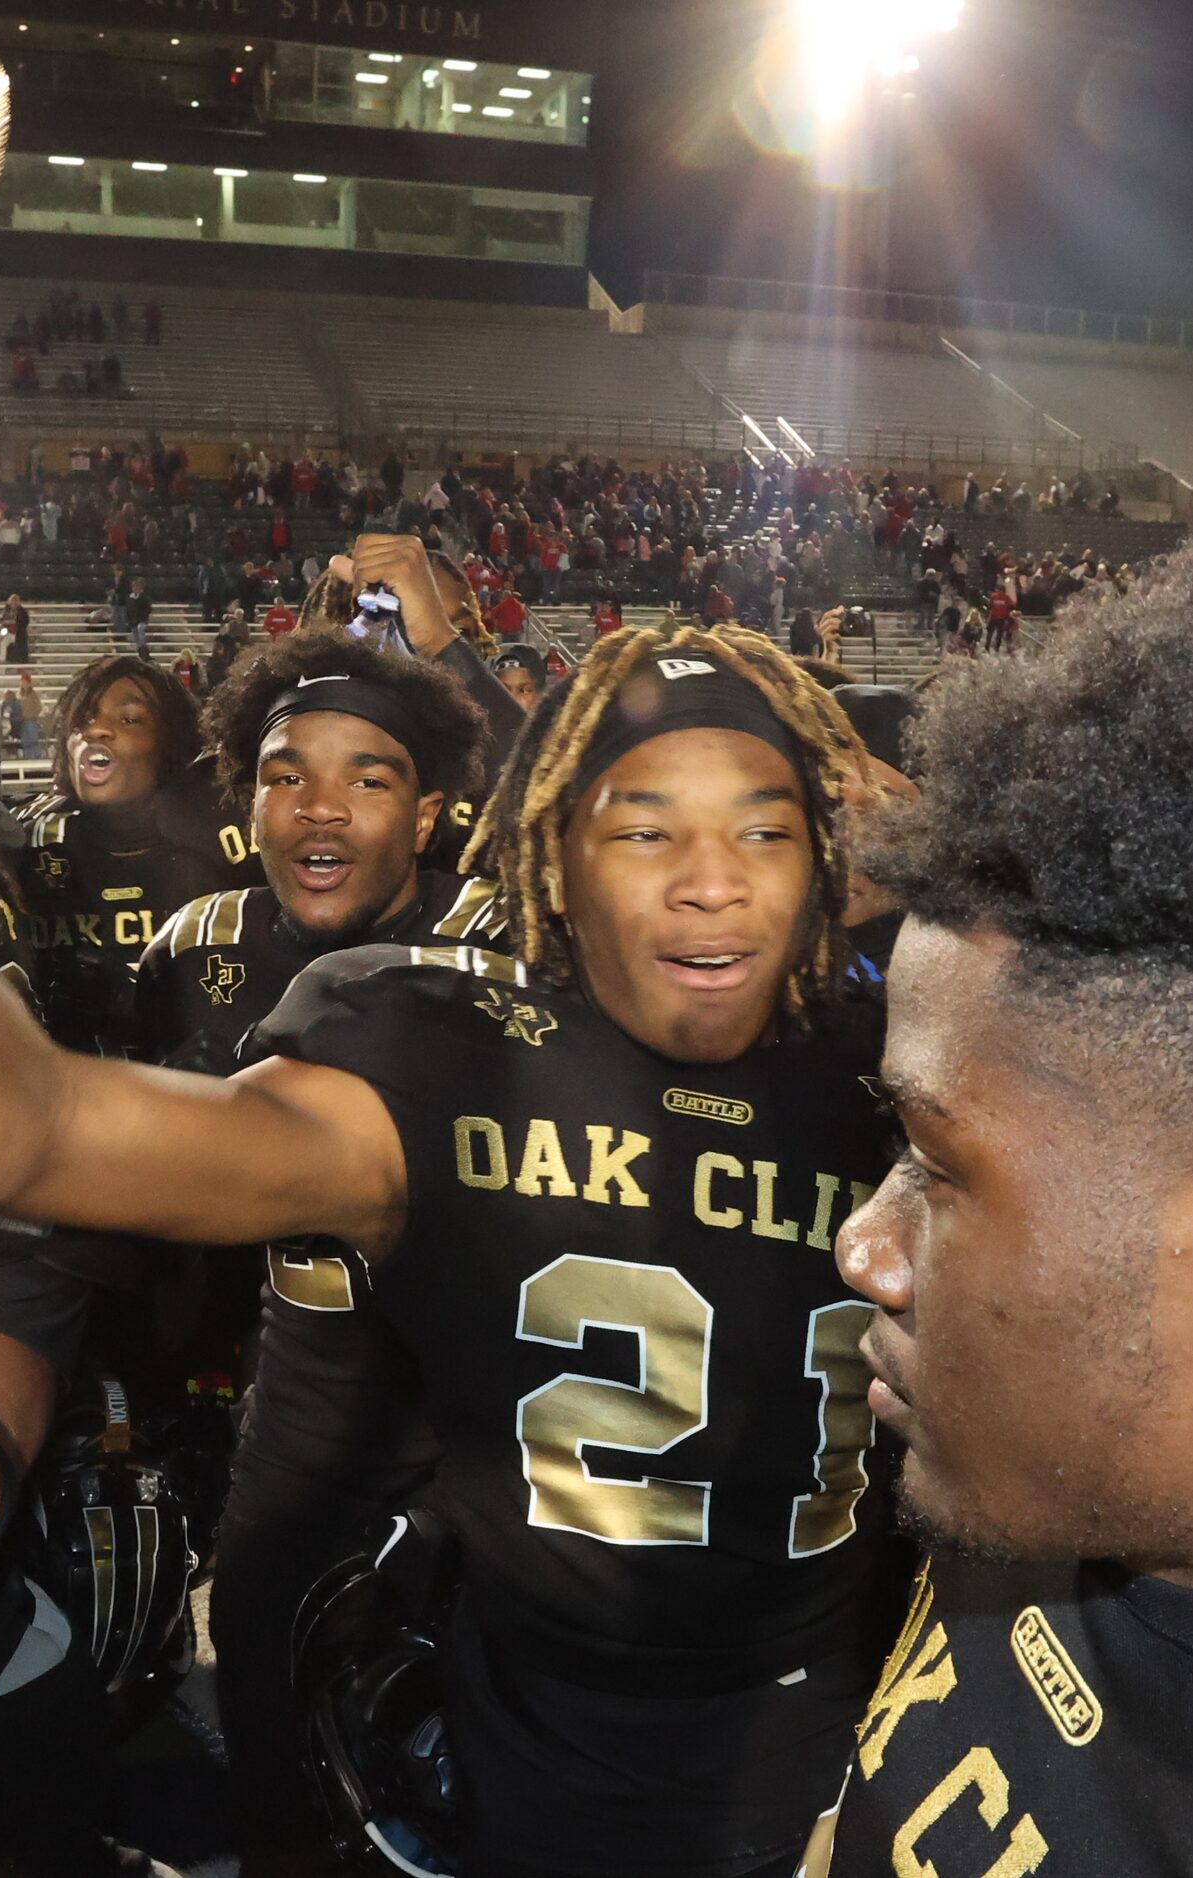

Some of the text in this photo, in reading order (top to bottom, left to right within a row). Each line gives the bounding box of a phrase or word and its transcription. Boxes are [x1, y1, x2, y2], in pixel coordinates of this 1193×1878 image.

[280, 0, 481, 40] STADIUM
[218, 967, 233, 986] 21
[669, 1092, 748, 1121] BATTLE
[453, 1115, 652, 1208] OAK
[514, 1252, 881, 1560] 21
[1014, 1613, 1094, 1733] BATTLE
